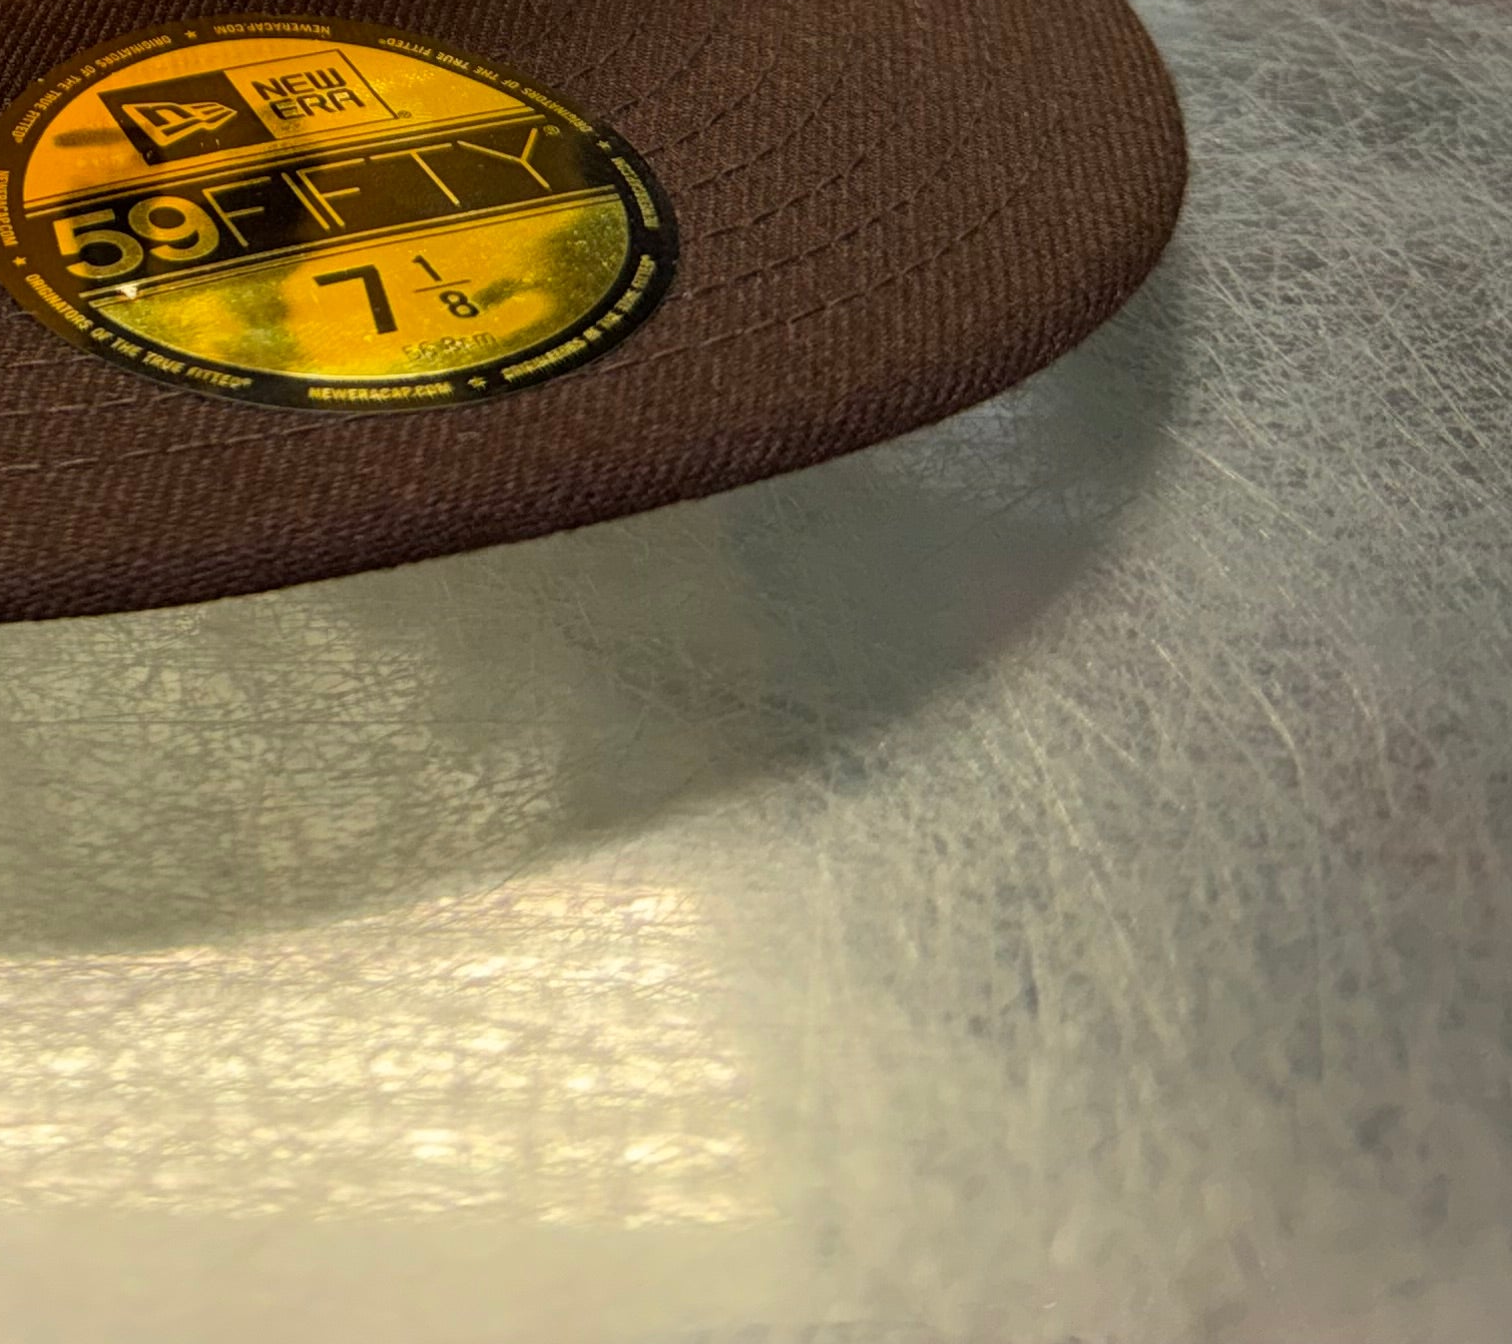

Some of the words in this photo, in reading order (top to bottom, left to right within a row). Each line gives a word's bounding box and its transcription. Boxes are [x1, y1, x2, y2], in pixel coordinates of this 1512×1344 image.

[213, 22, 331, 36] NEWERACAP.COM
[95, 35, 172, 68] ORIGINATORS
[436, 51, 470, 71] TRUE
[80, 66, 96, 77] OF
[57, 75, 81, 91] THE
[251, 68, 346, 100] NEW
[500, 78, 520, 90] OF
[39, 89, 63, 111] TRUE
[269, 88, 365, 120] ERA
[312, 264, 398, 334] 7
[25, 273, 94, 331] ORIGINATORS
[90, 326, 114, 342] OF
[110, 337, 143, 358] THE
[142, 351, 186, 374] TRUE
[308, 381, 455, 401] NEWERACAP.COM
